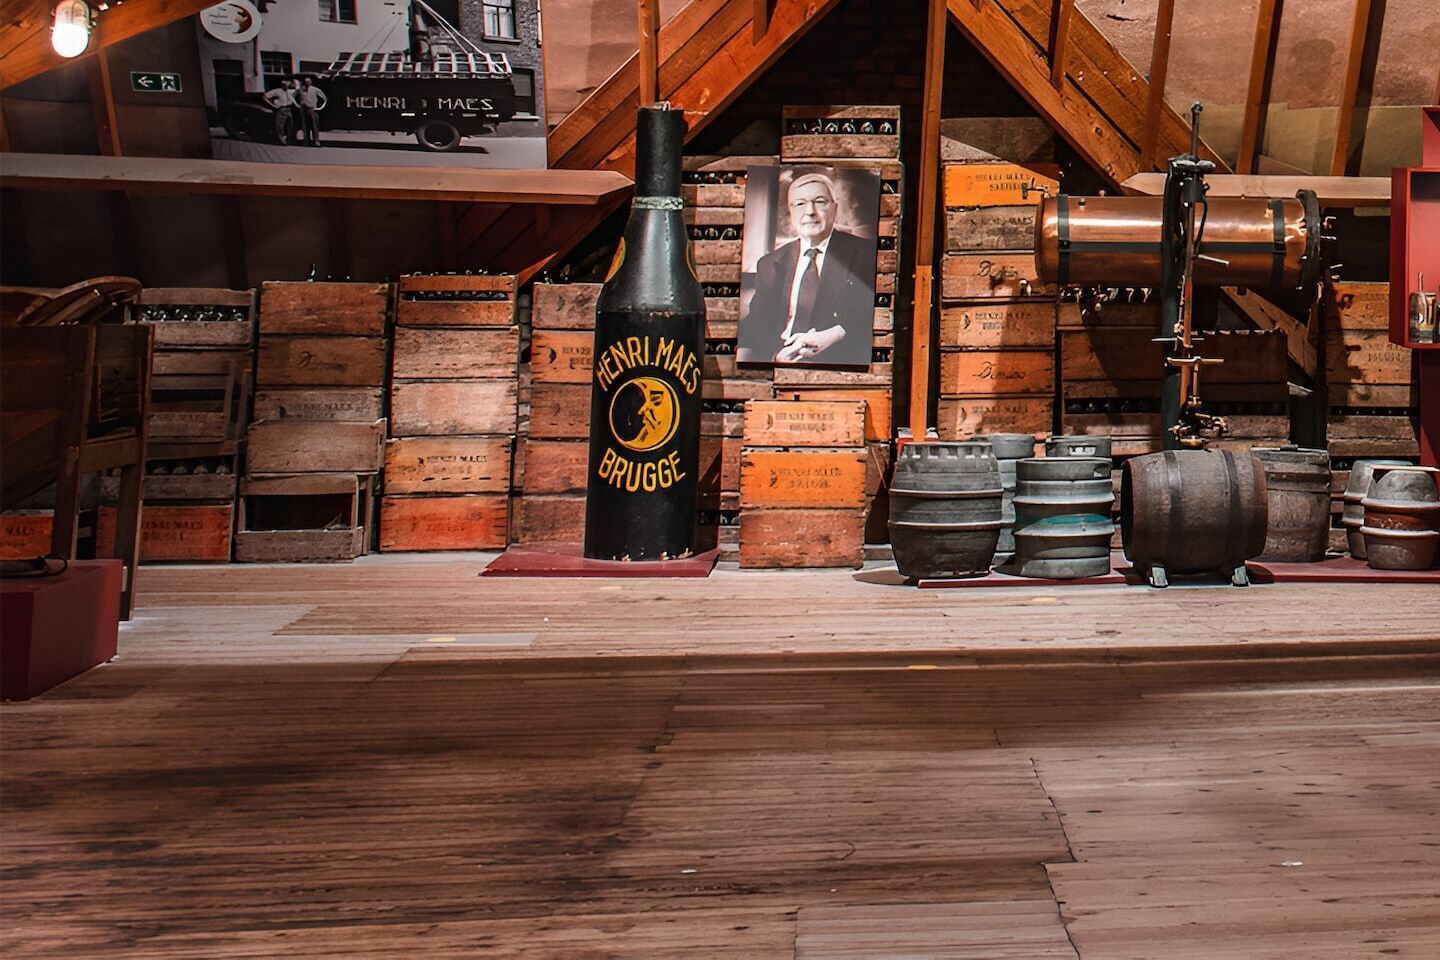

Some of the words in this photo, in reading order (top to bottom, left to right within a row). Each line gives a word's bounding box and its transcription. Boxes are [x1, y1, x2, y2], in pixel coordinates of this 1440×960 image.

[345, 95, 407, 111] HENRI
[437, 97, 495, 112] MAES
[654, 335, 701, 395] MAES
[597, 446, 687, 493] BRUGGE
